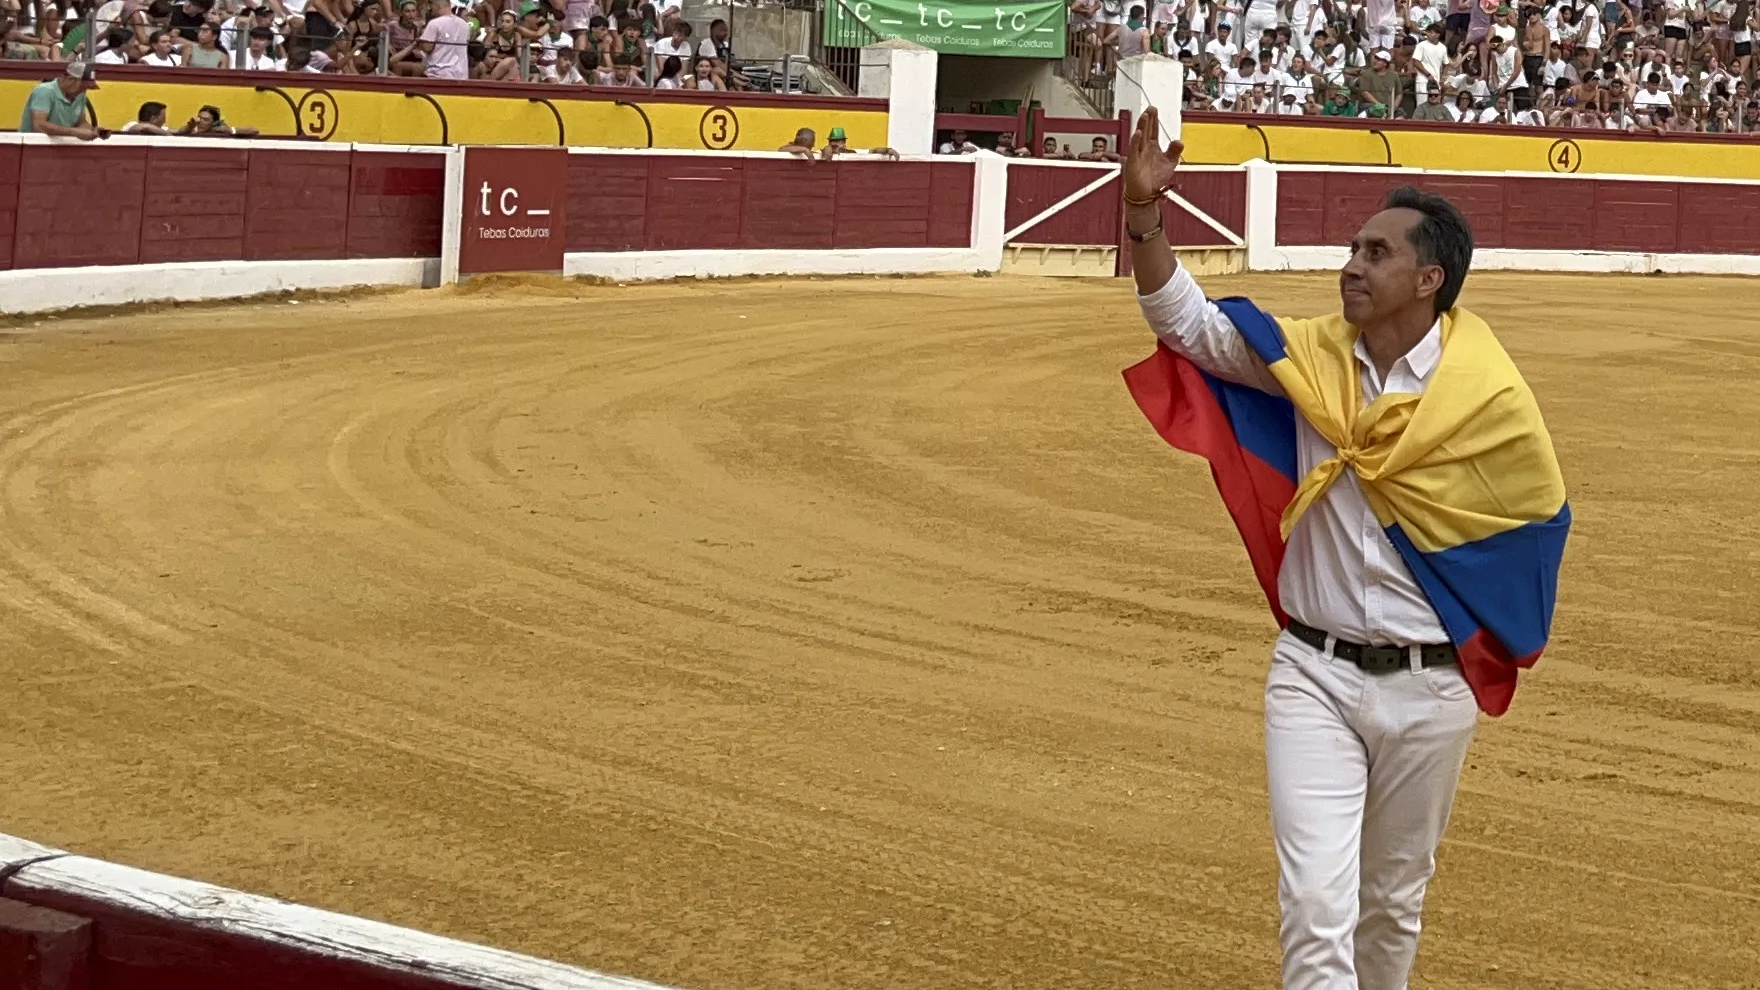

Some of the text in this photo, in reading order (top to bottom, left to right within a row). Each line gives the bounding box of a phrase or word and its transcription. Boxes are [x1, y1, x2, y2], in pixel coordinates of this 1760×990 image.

[915, 33, 942, 44] Tebas
[309, 101, 325, 133] 3
[712, 114, 727, 142] 3
[1557, 145, 1569, 168] 4
[479, 227, 507, 239] Tebas
